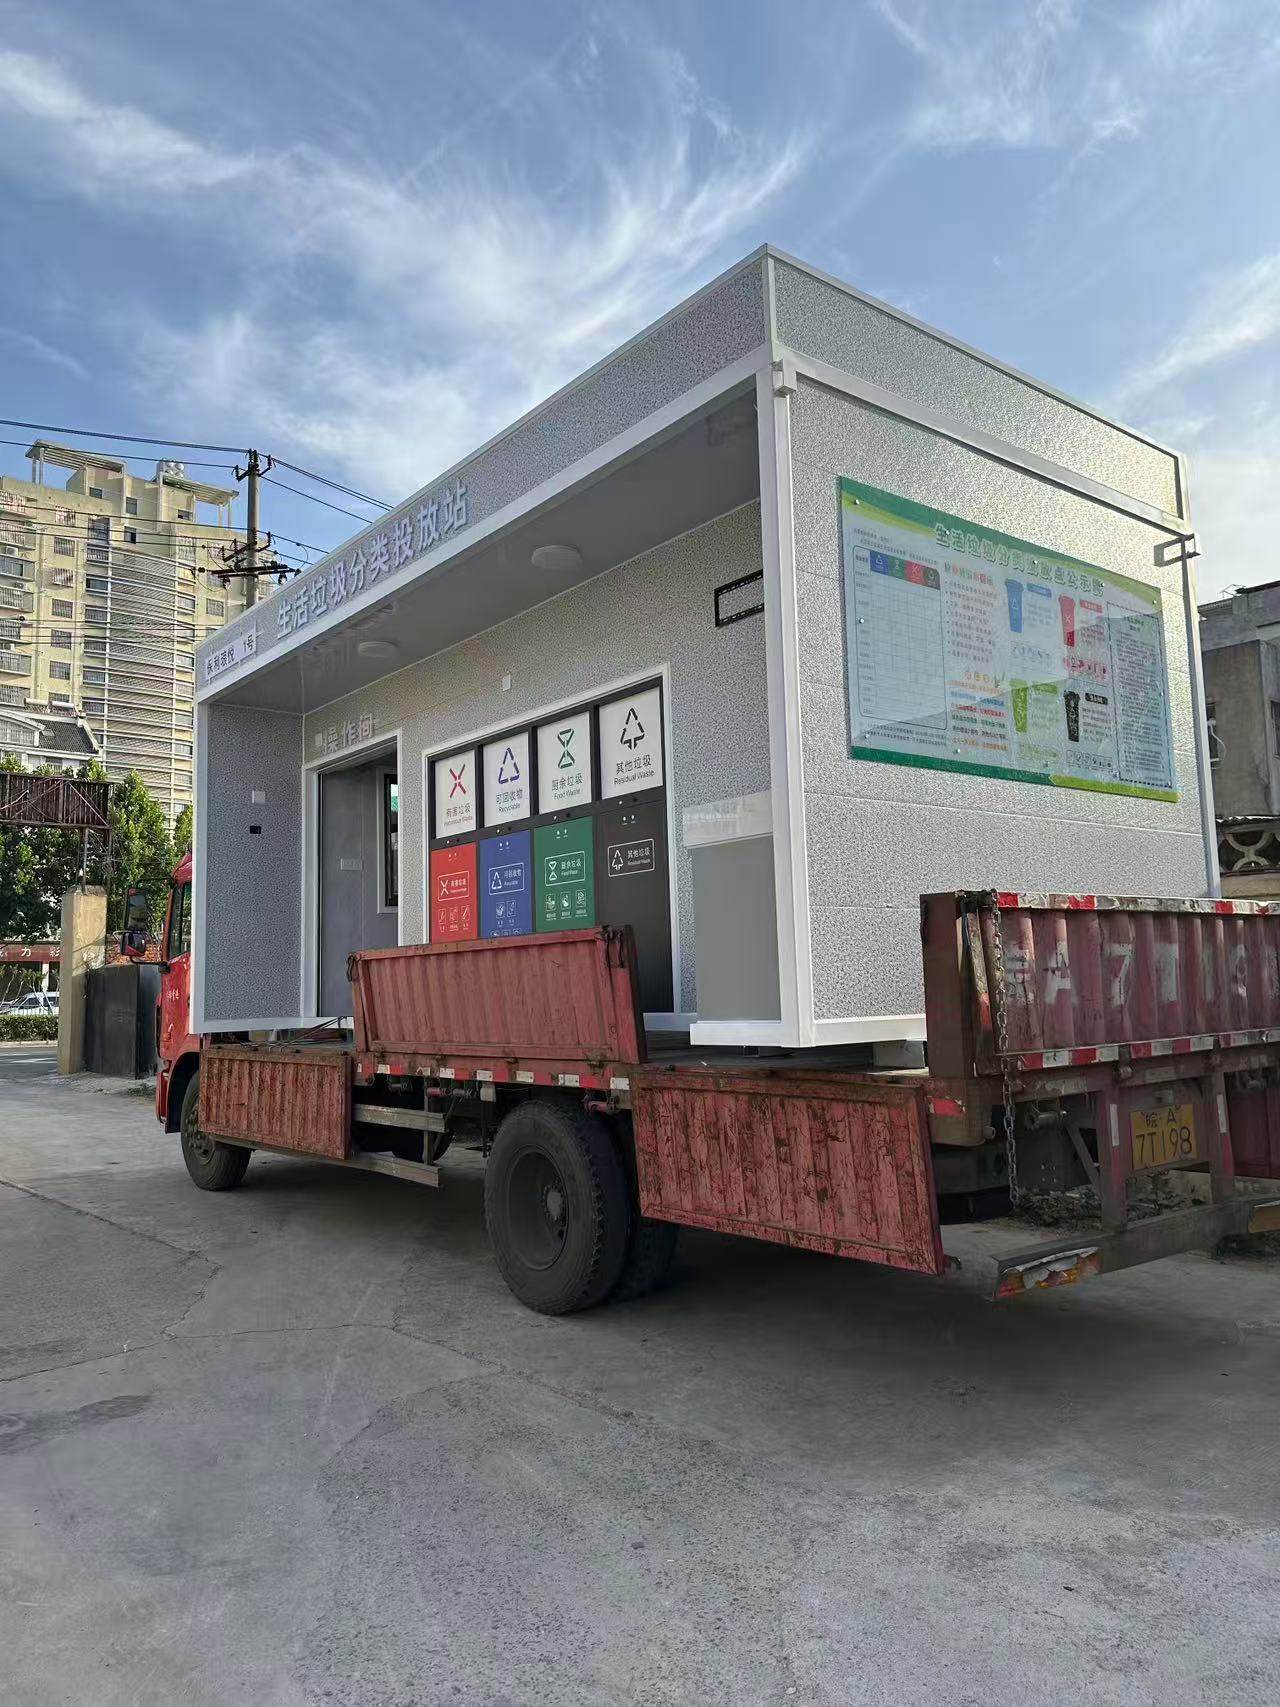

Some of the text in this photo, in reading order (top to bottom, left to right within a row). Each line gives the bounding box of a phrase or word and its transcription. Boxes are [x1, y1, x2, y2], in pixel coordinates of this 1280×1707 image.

[276, 479, 470, 640] 生活垃圾分类投放站
[616, 754, 652, 775] 其他垃圾
[551, 773, 582, 791] 厨余垃圾
[614, 770, 655, 785] Residual Waste
[496, 789, 523, 804] 可回收物
[1135, 1126, 1193, 1164] 7T198
